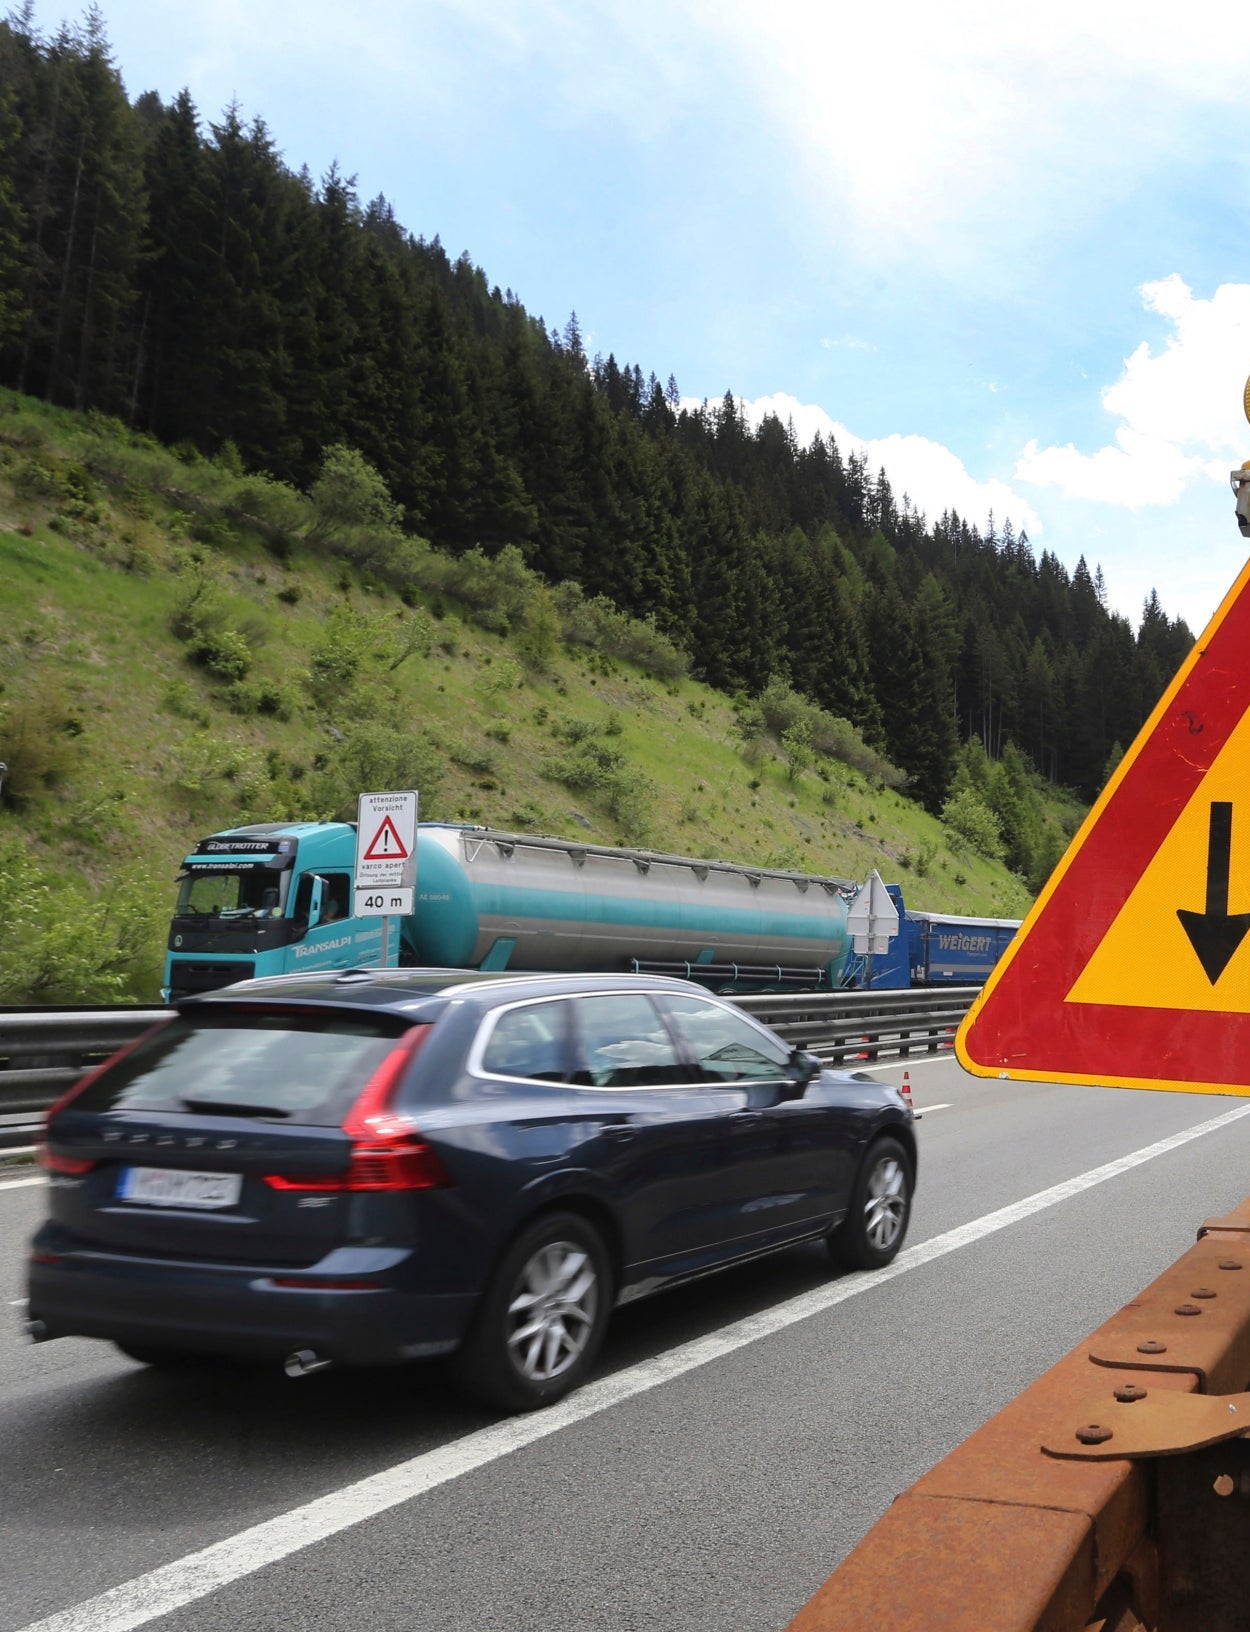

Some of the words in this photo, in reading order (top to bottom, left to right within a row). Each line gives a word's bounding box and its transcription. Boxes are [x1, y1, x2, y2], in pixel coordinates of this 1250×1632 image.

[369, 796, 408, 804] attenzione
[207, 841, 269, 850] GLOBETROTTER
[385, 862, 405, 870] apert
[364, 896, 384, 908] 40
[390, 897, 402, 907] m
[292, 936, 351, 958] TRANSALPI
